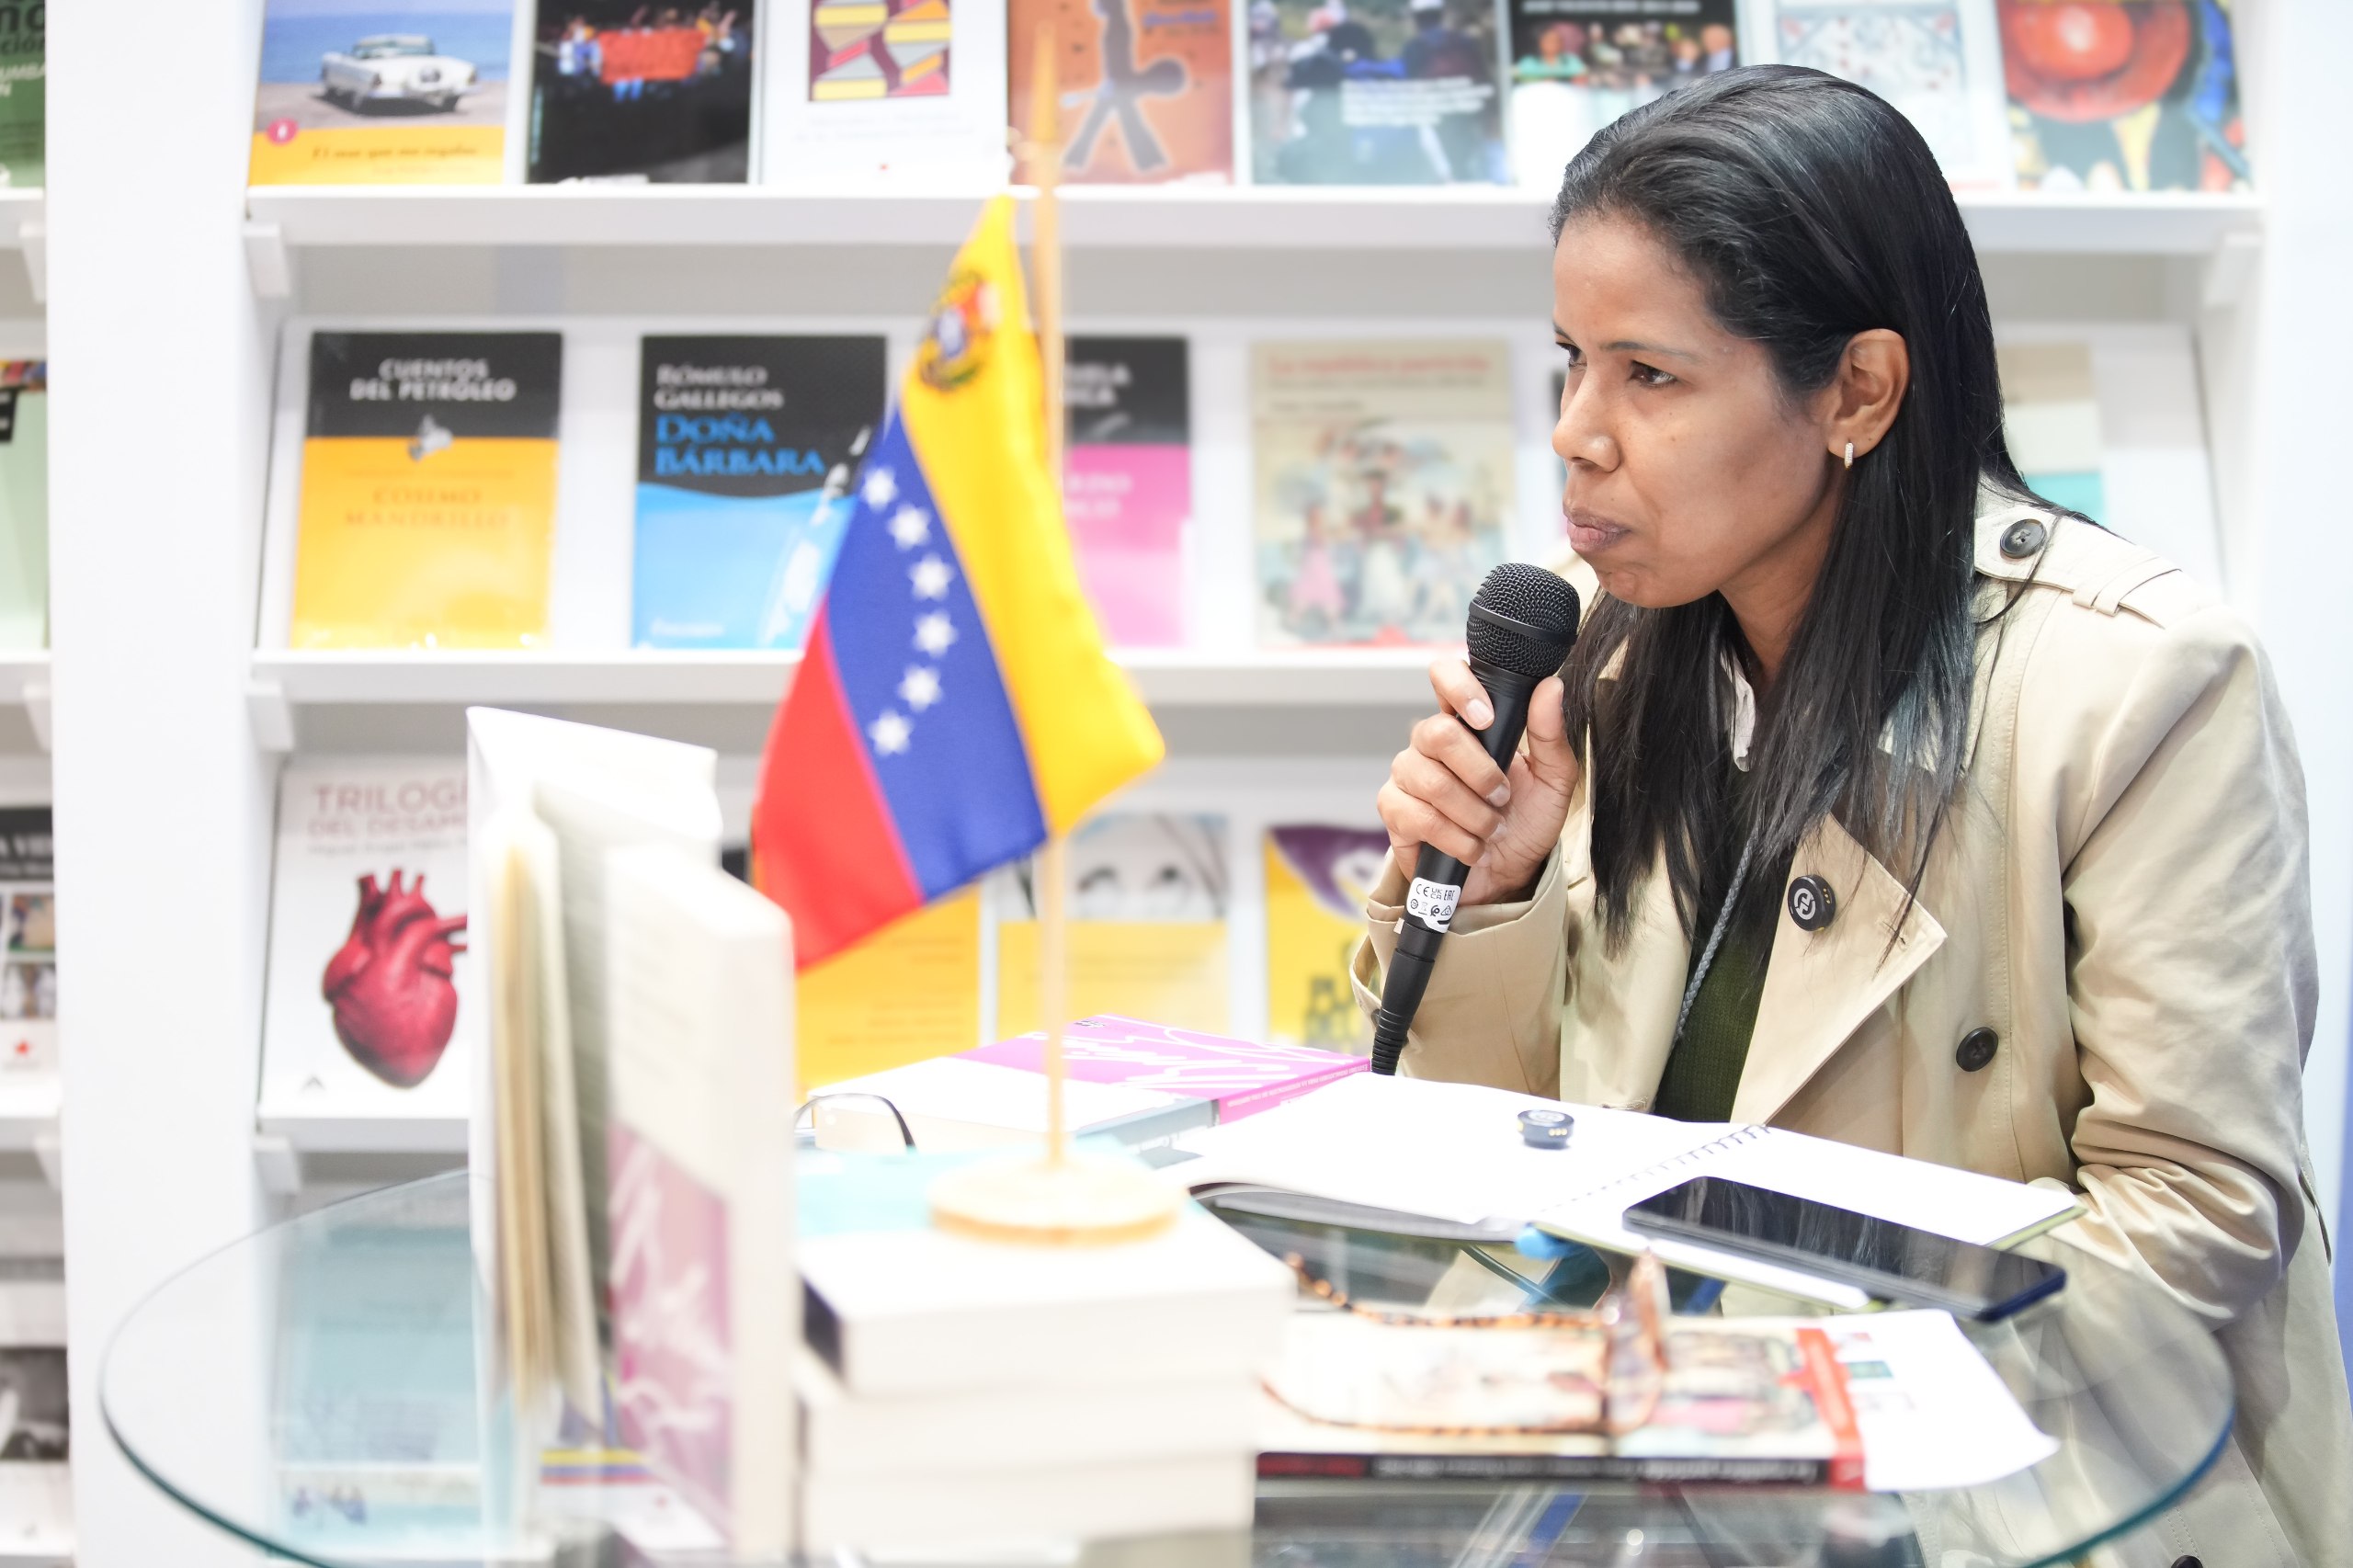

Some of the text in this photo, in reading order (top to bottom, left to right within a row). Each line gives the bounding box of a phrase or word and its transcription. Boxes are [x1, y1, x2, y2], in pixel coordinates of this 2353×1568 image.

[379, 358, 489, 381] CUENTOS
[656, 361, 768, 387] RÓMULO
[349, 378, 392, 401] DEL
[654, 387, 784, 411] GALLEGOS
[655, 411, 776, 443] DOÑA
[654, 442, 825, 476] BÁRBARA
[314, 778, 468, 814] TRILOGI
[367, 812, 468, 838] DESAM
